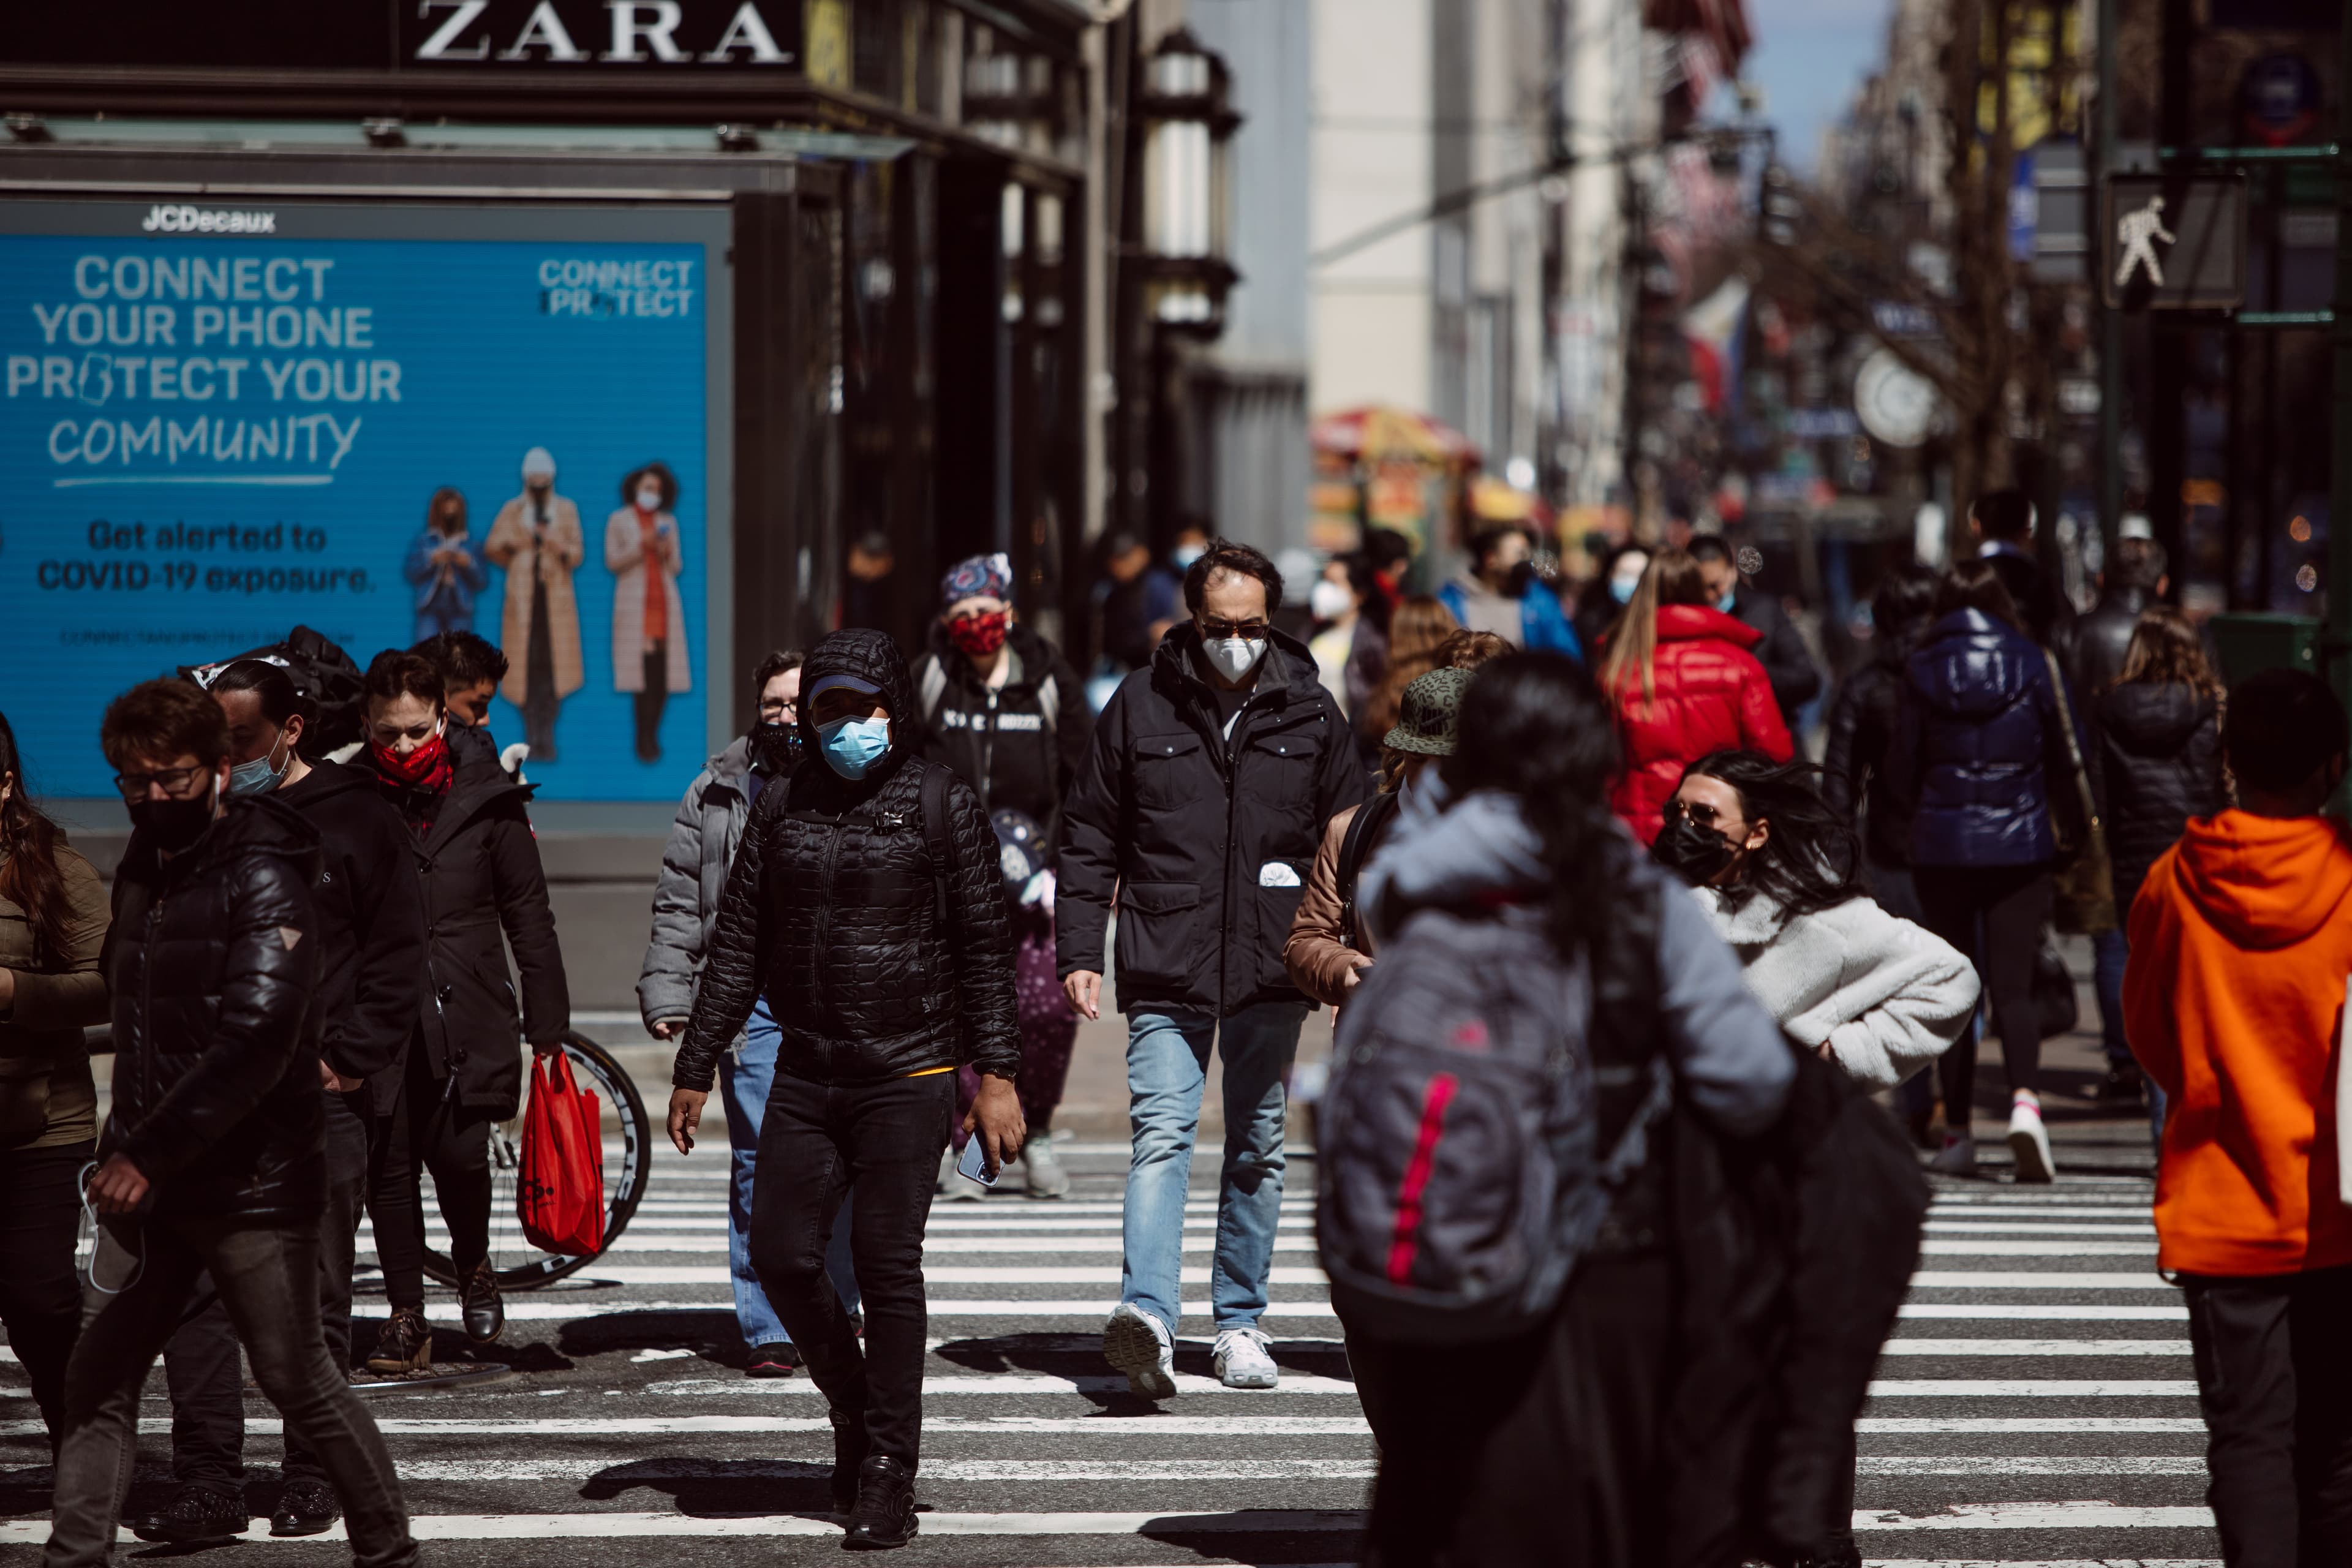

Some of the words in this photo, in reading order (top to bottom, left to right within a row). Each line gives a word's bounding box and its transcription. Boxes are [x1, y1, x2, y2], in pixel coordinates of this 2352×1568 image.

[415, 0, 794, 62] ZARA
[141, 205, 276, 233] JCDecaux
[75, 255, 334, 301] CONNECT
[538, 260, 693, 288] CONNECT
[32, 303, 176, 346] YOUR
[193, 306, 374, 349] PHONE
[261, 358, 401, 402] YOUR
[48, 413, 362, 470] COMMUNITY
[88, 519, 148, 552] Get
[156, 521, 283, 552] alerted
[290, 522, 326, 553] to
[37, 560, 197, 591] COVID-19
